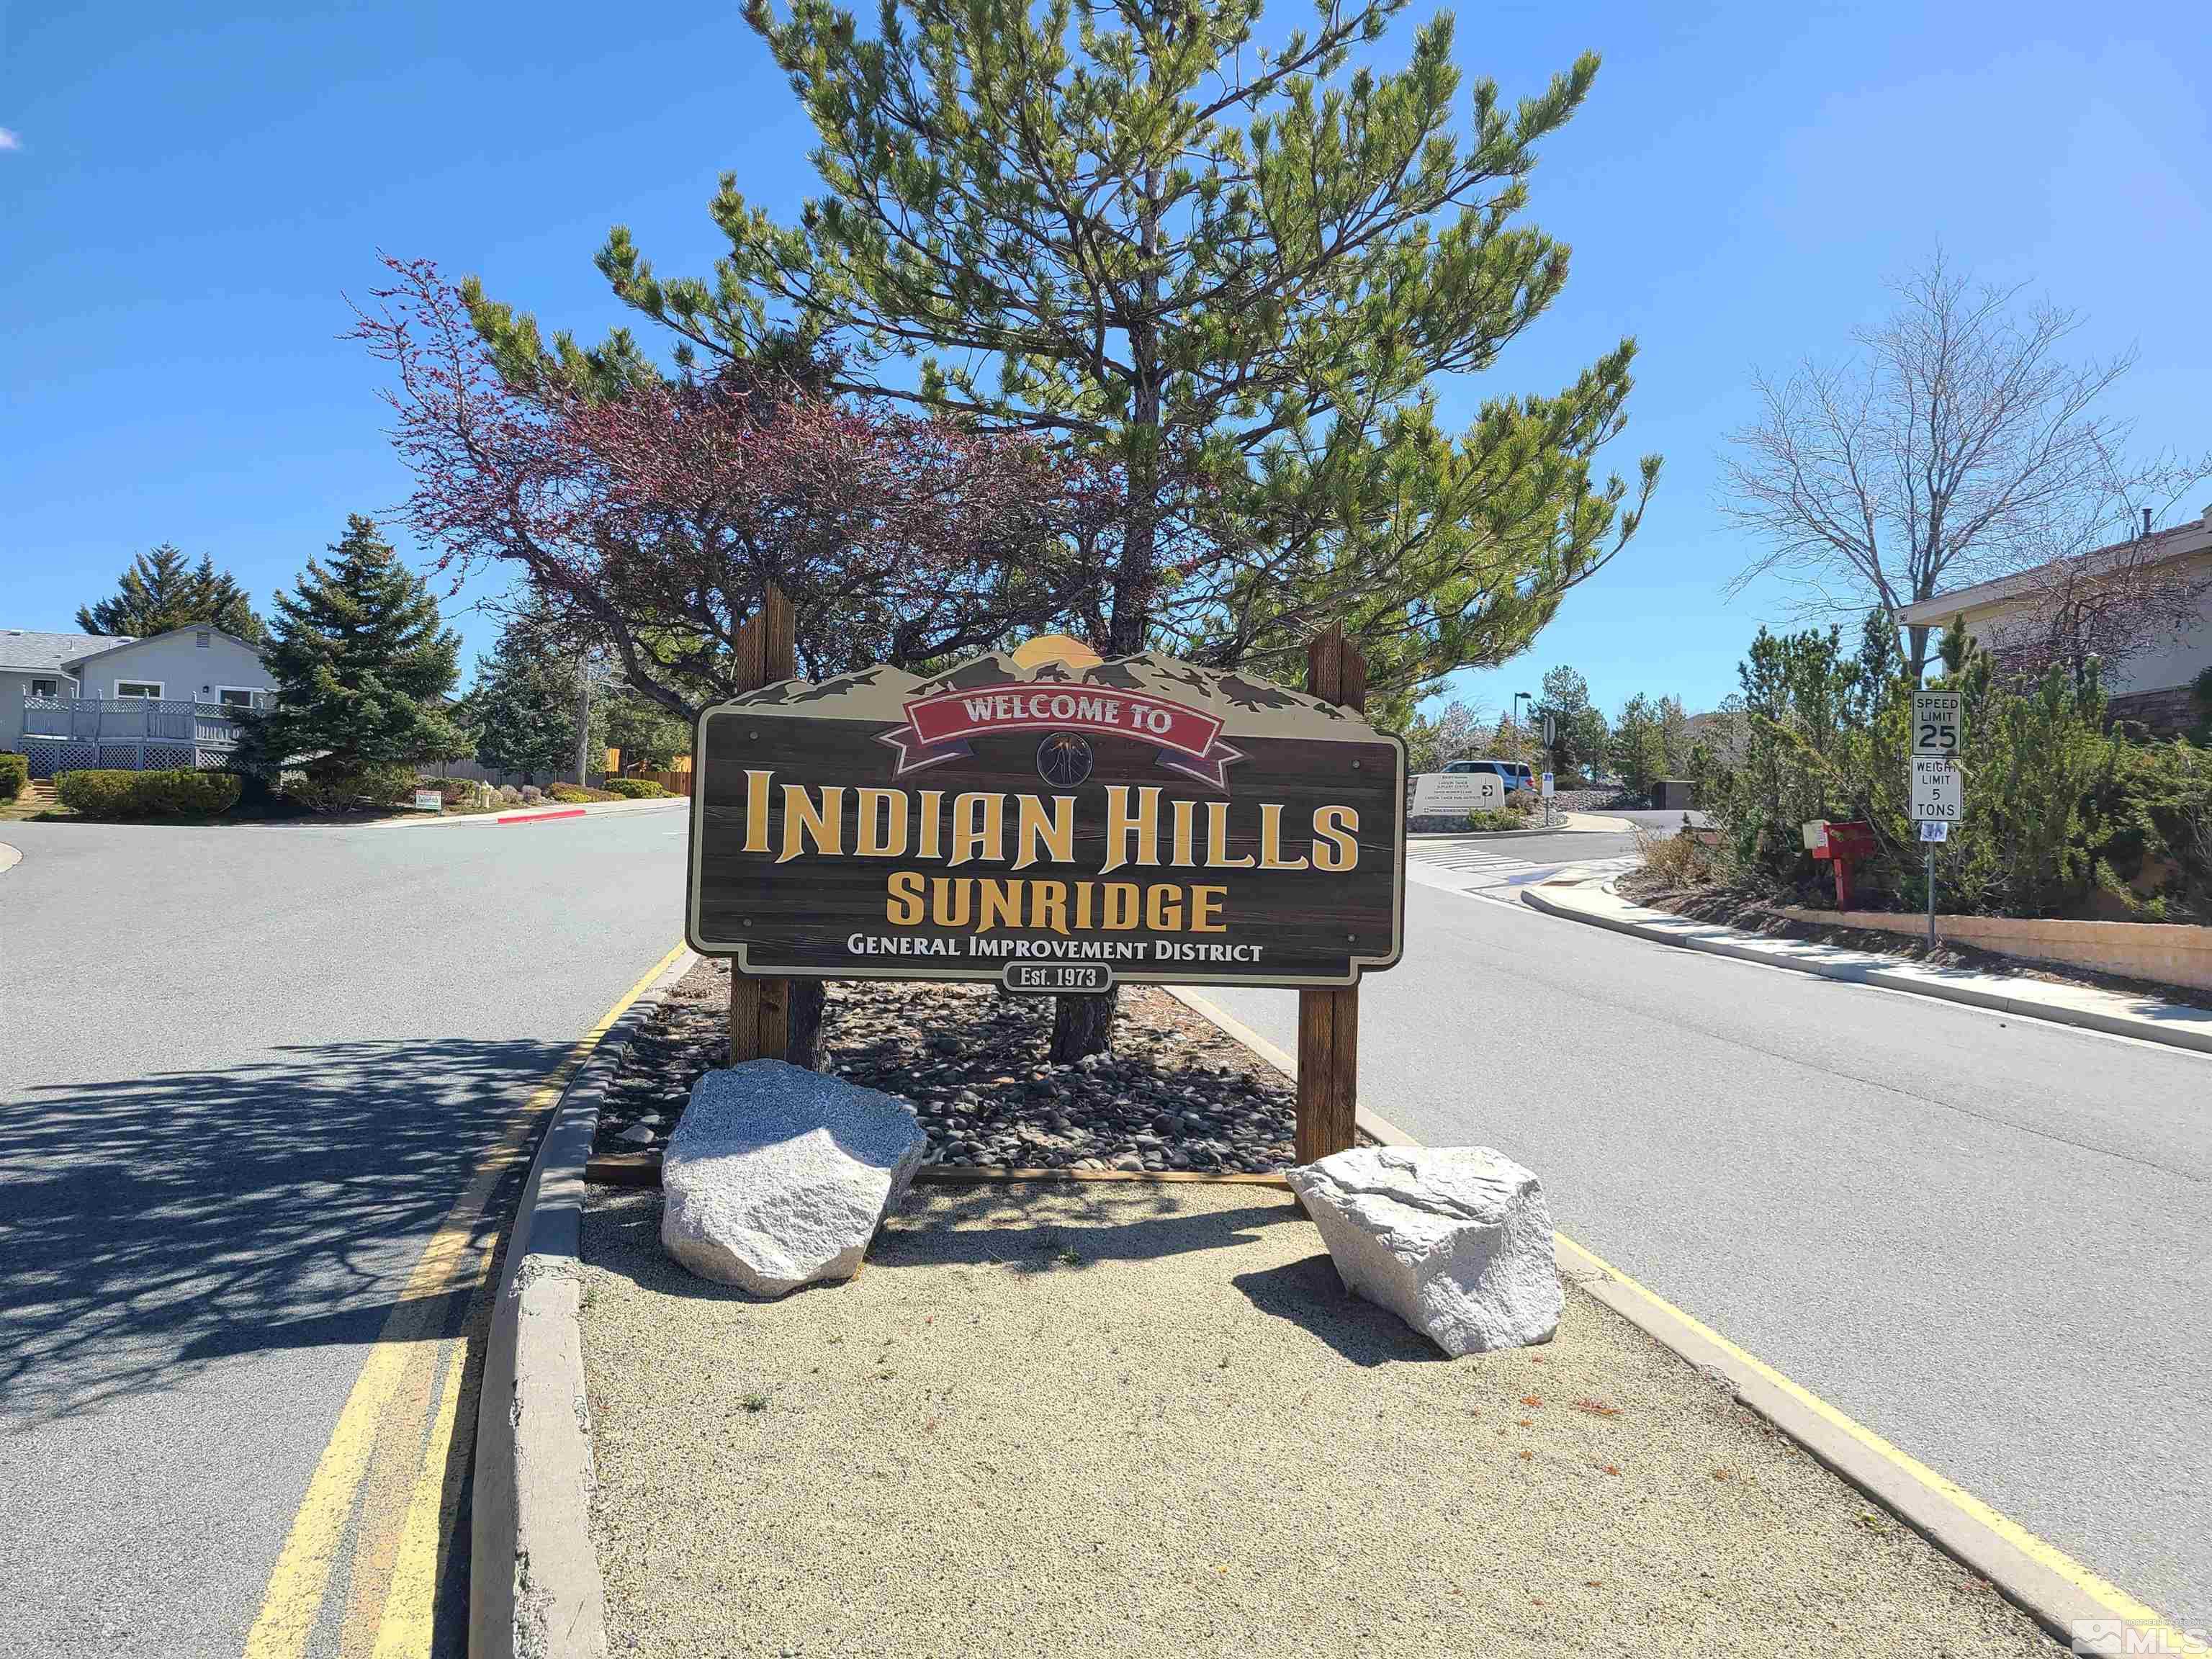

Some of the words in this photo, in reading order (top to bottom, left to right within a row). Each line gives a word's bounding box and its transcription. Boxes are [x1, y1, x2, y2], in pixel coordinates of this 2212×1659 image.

[1917, 699, 1958, 709] SPEED
[963, 694, 1120, 722] WELCOME
[1130, 703, 1173, 733] TO
[1921, 712, 1954, 721] LIMIT
[1919, 724, 1956, 748] 25
[1922, 775, 1951, 785] LIMIT
[1933, 789, 1941, 801] 5
[1918, 804, 1954, 816] TONS
[741, 770, 1077, 871] INDIAN
[1097, 785, 1361, 876] HILLS
[887, 872, 1228, 935] SUNRIDGE
[847, 933, 961, 956] GENERAL
[968, 936, 1148, 961] IMPROVEMENT
[1155, 940, 1264, 963] DISTRICT
[1020, 968, 1049, 986] Est.
[1056, 969, 1097, 986] 1973
